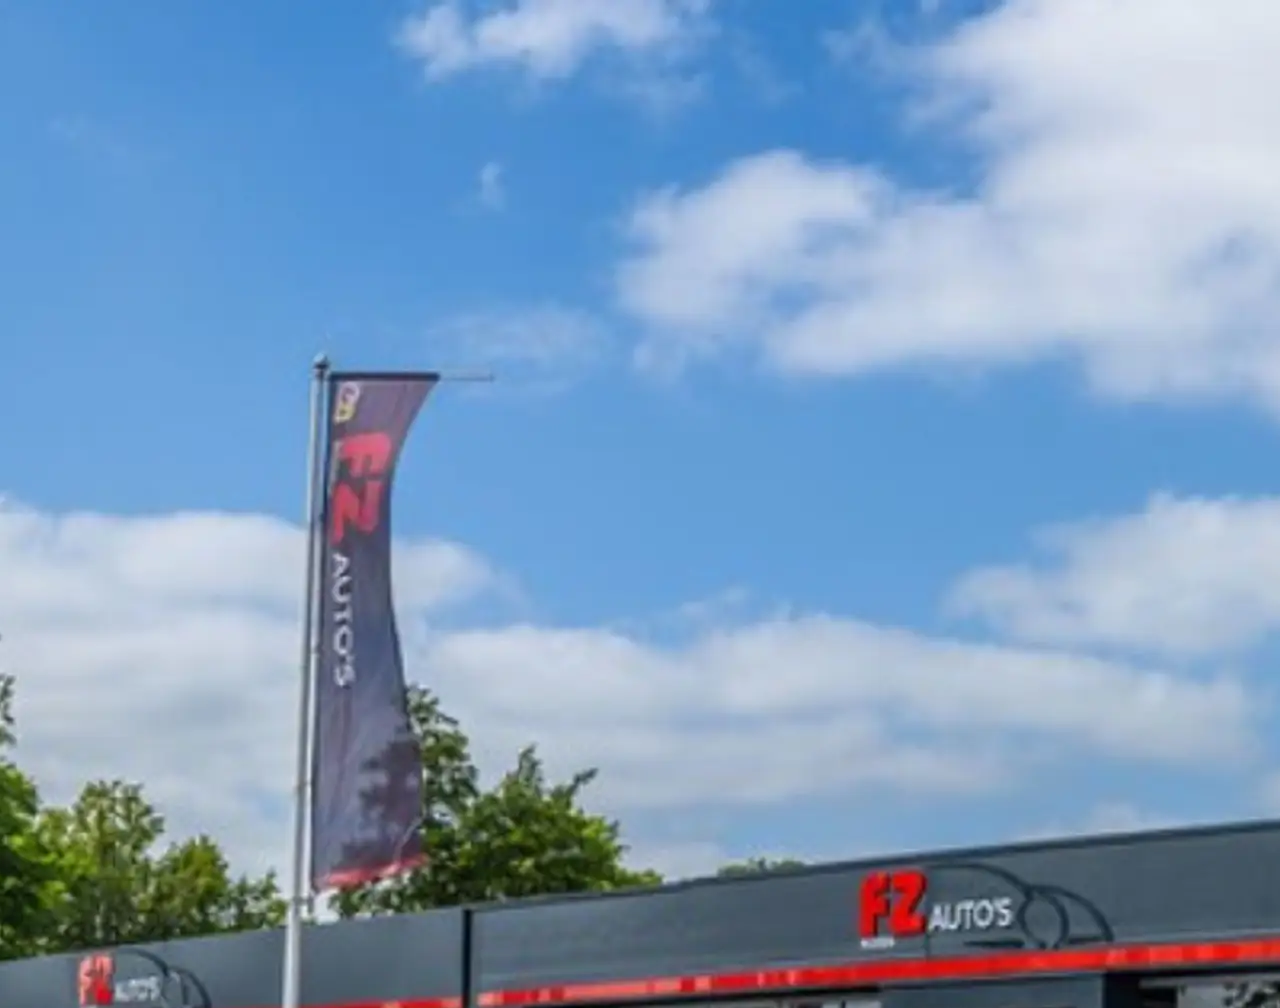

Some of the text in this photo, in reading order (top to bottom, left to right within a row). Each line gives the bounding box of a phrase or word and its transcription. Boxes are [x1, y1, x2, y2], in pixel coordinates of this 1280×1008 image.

[328, 432, 392, 544] FZ
[860, 868, 1014, 938] FZ AUTO'S
